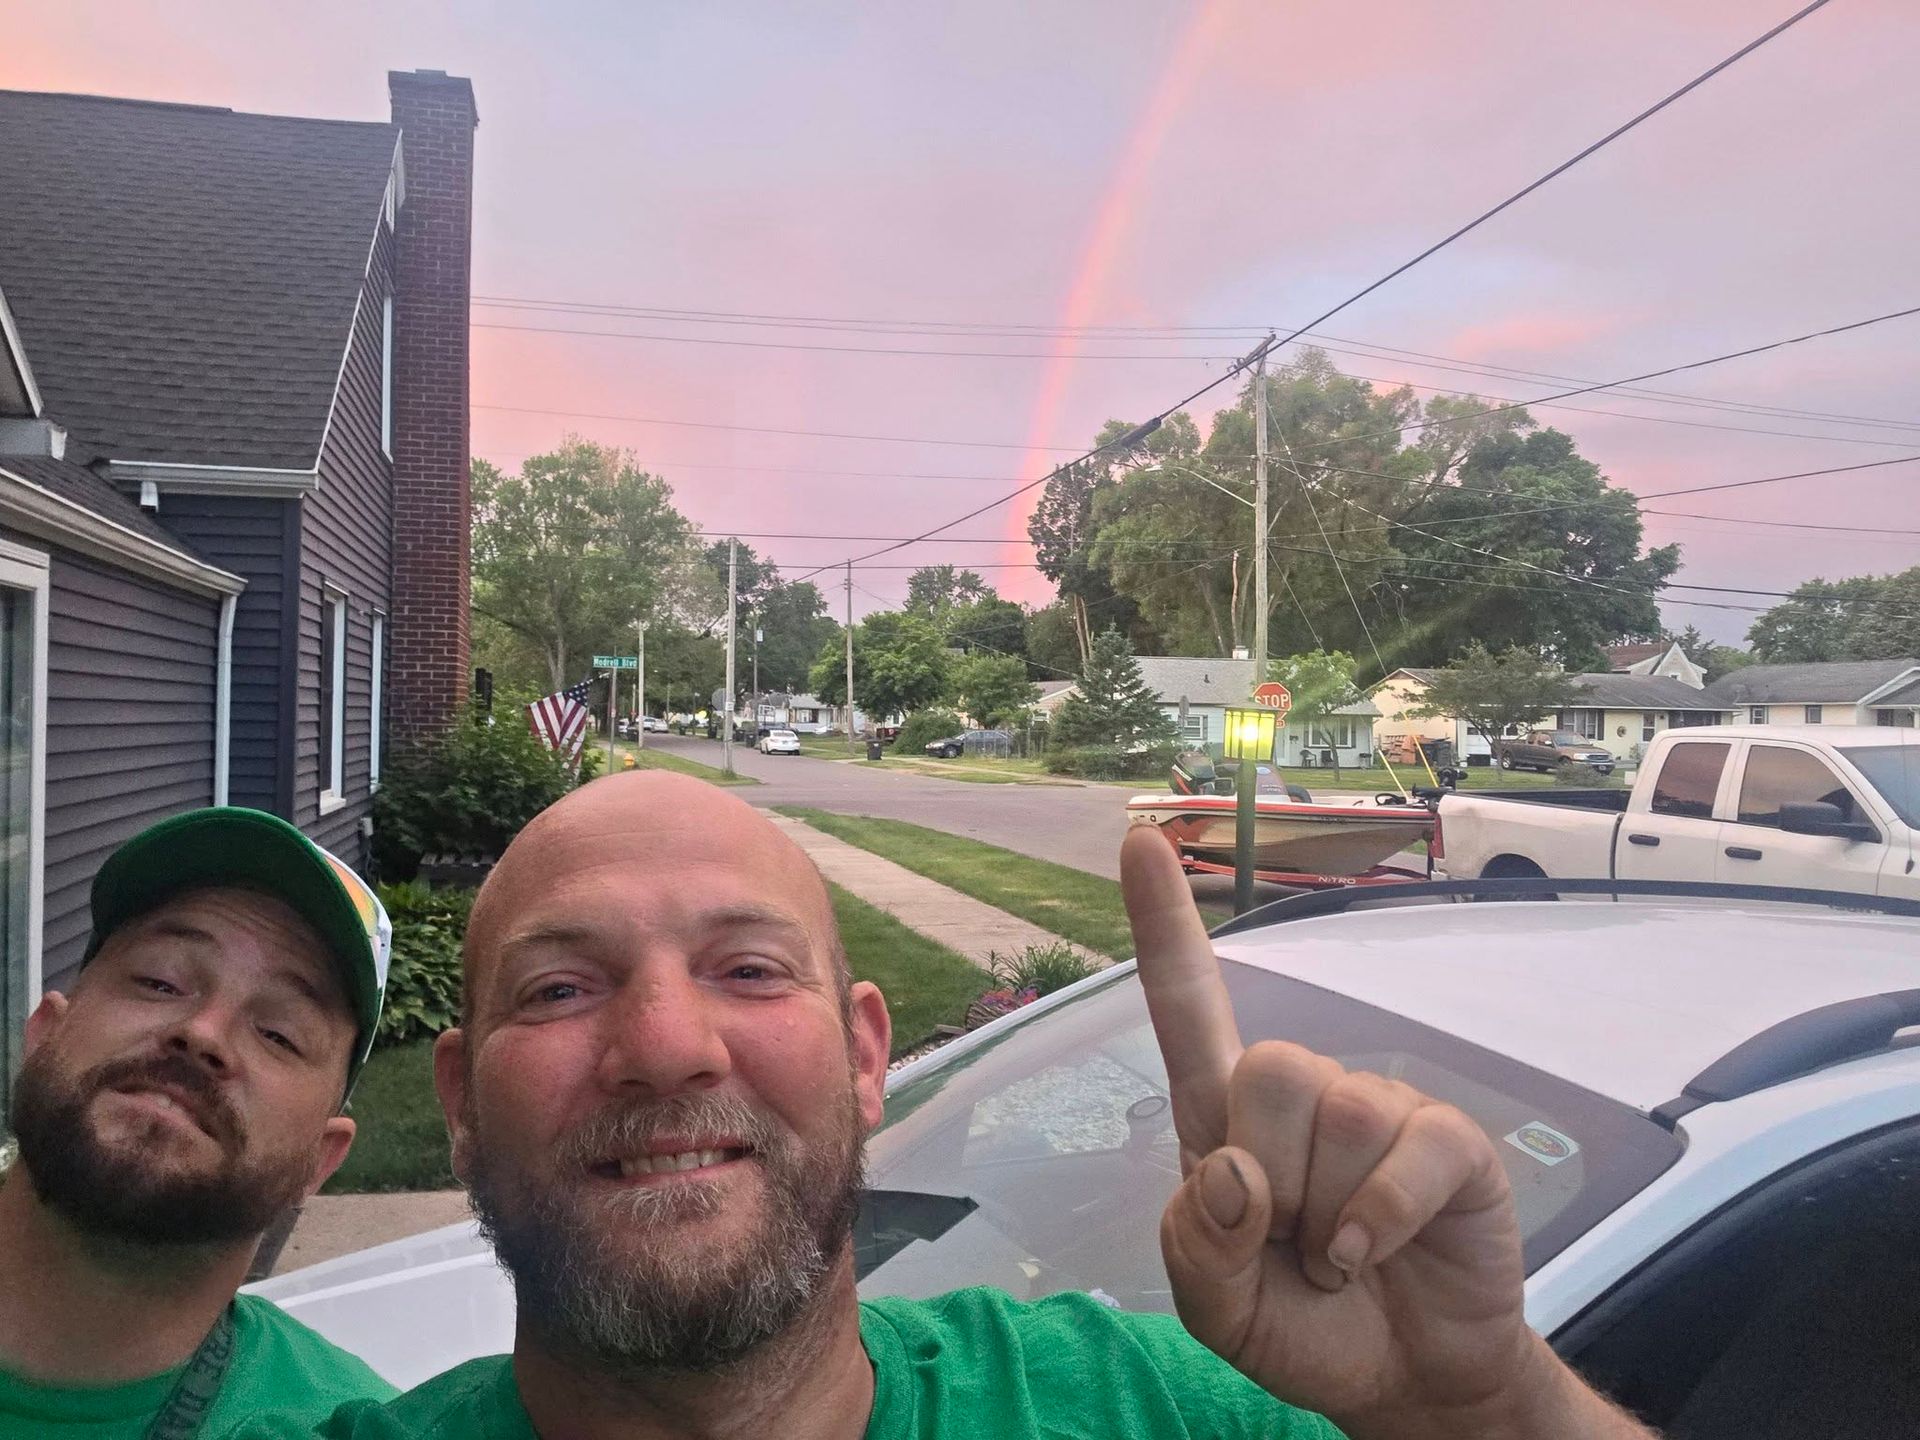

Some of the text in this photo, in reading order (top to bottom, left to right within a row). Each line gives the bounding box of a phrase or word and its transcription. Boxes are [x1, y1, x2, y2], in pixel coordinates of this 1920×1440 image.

[622, 659, 637, 668] Blvd
[1255, 693, 1289, 708] STOP
[1319, 876, 1356, 884] NITRO
